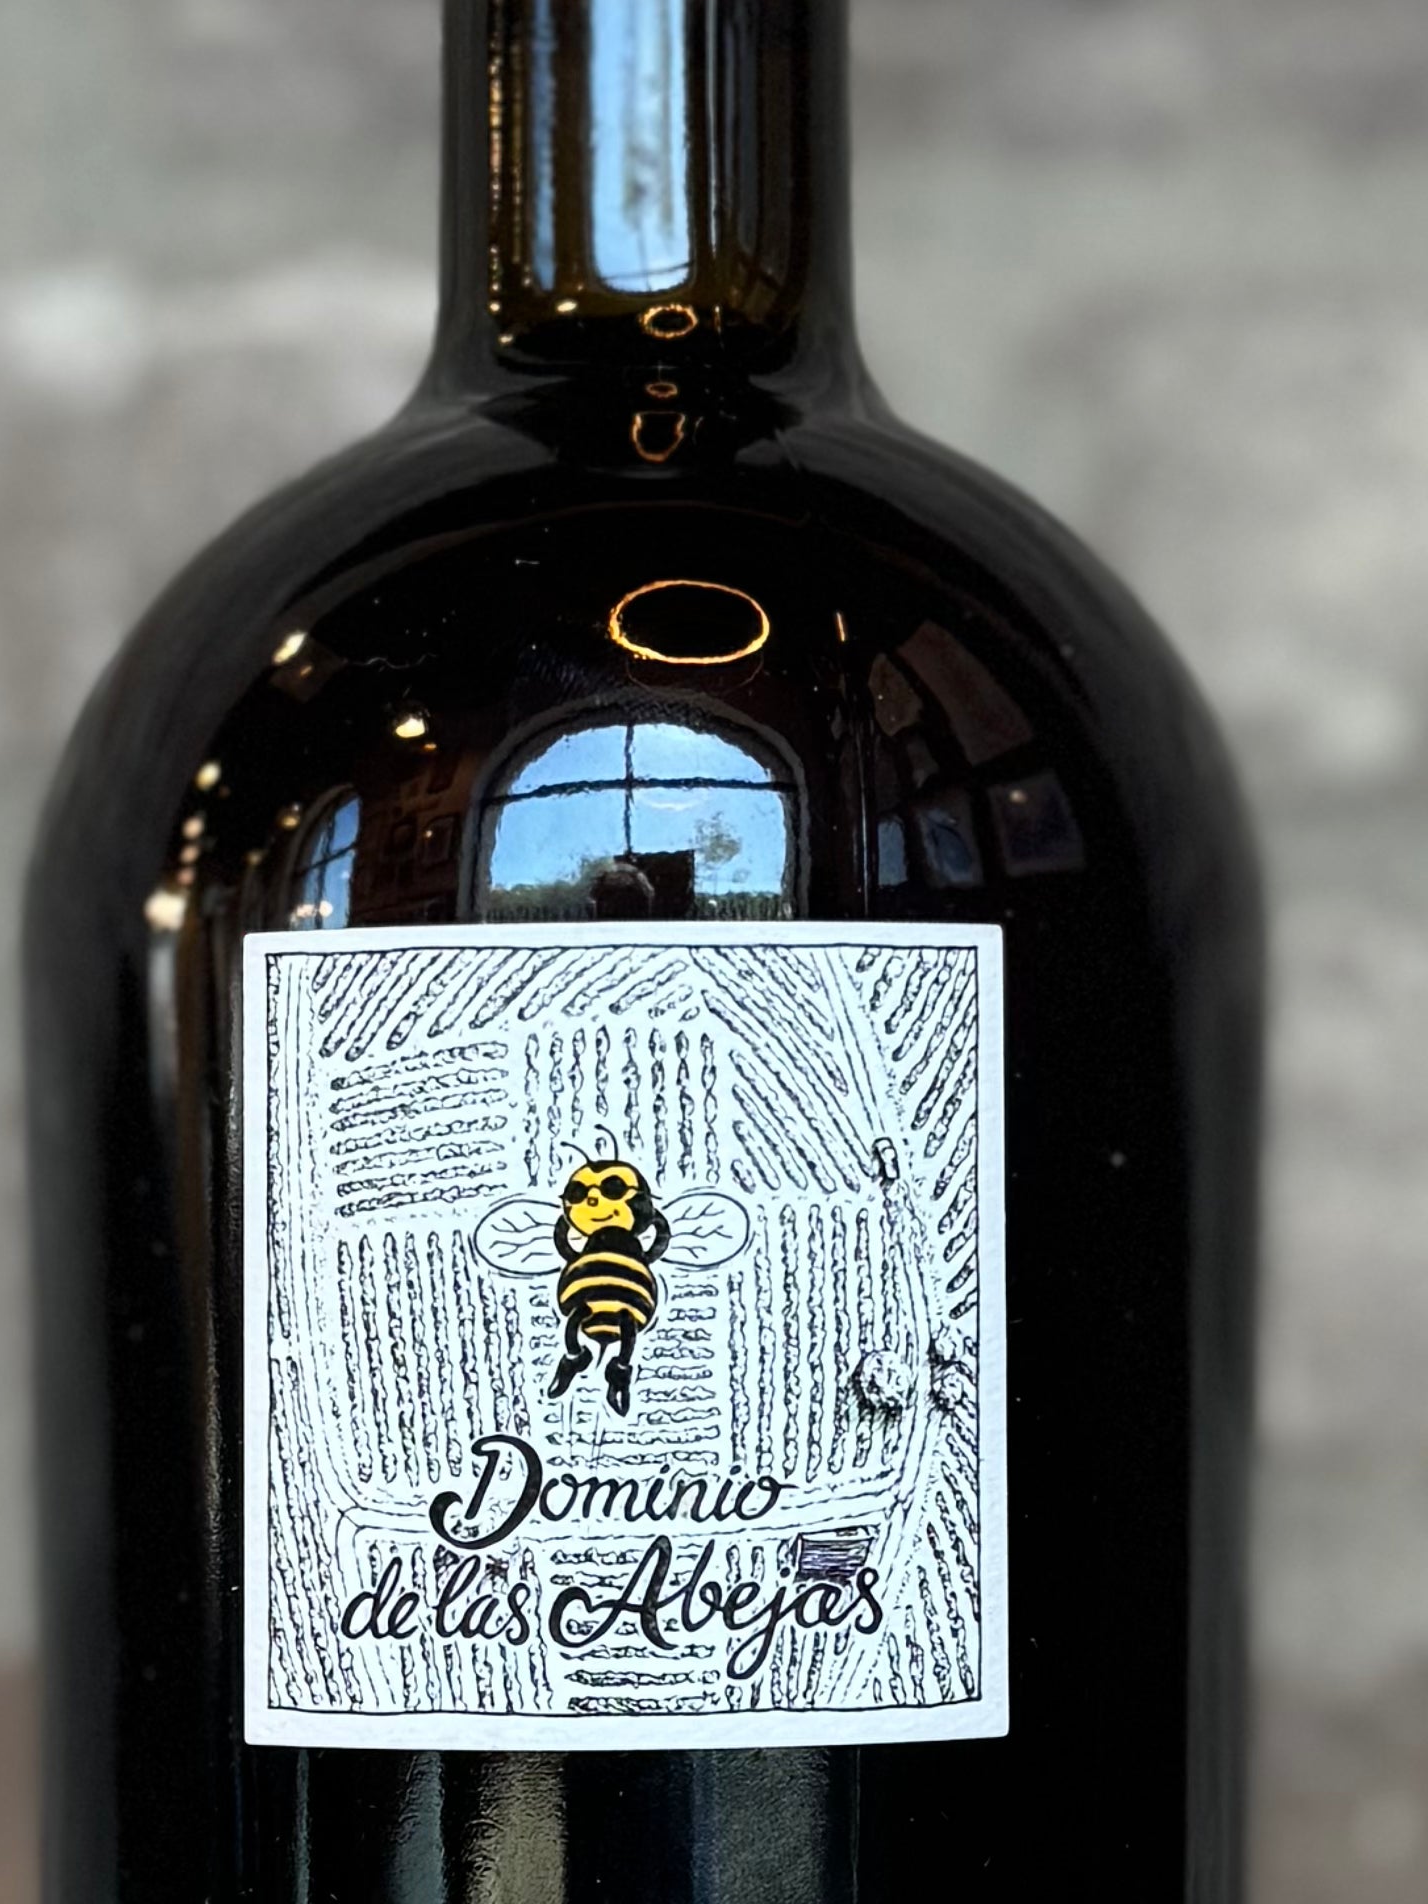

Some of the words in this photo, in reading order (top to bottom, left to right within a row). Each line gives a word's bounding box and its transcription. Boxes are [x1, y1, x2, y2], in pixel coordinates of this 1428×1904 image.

[429, 1434, 798, 1550] Dominio
[339, 1556, 420, 1641] de
[431, 1555, 531, 1647] las
[548, 1534, 884, 1680] Abejas
